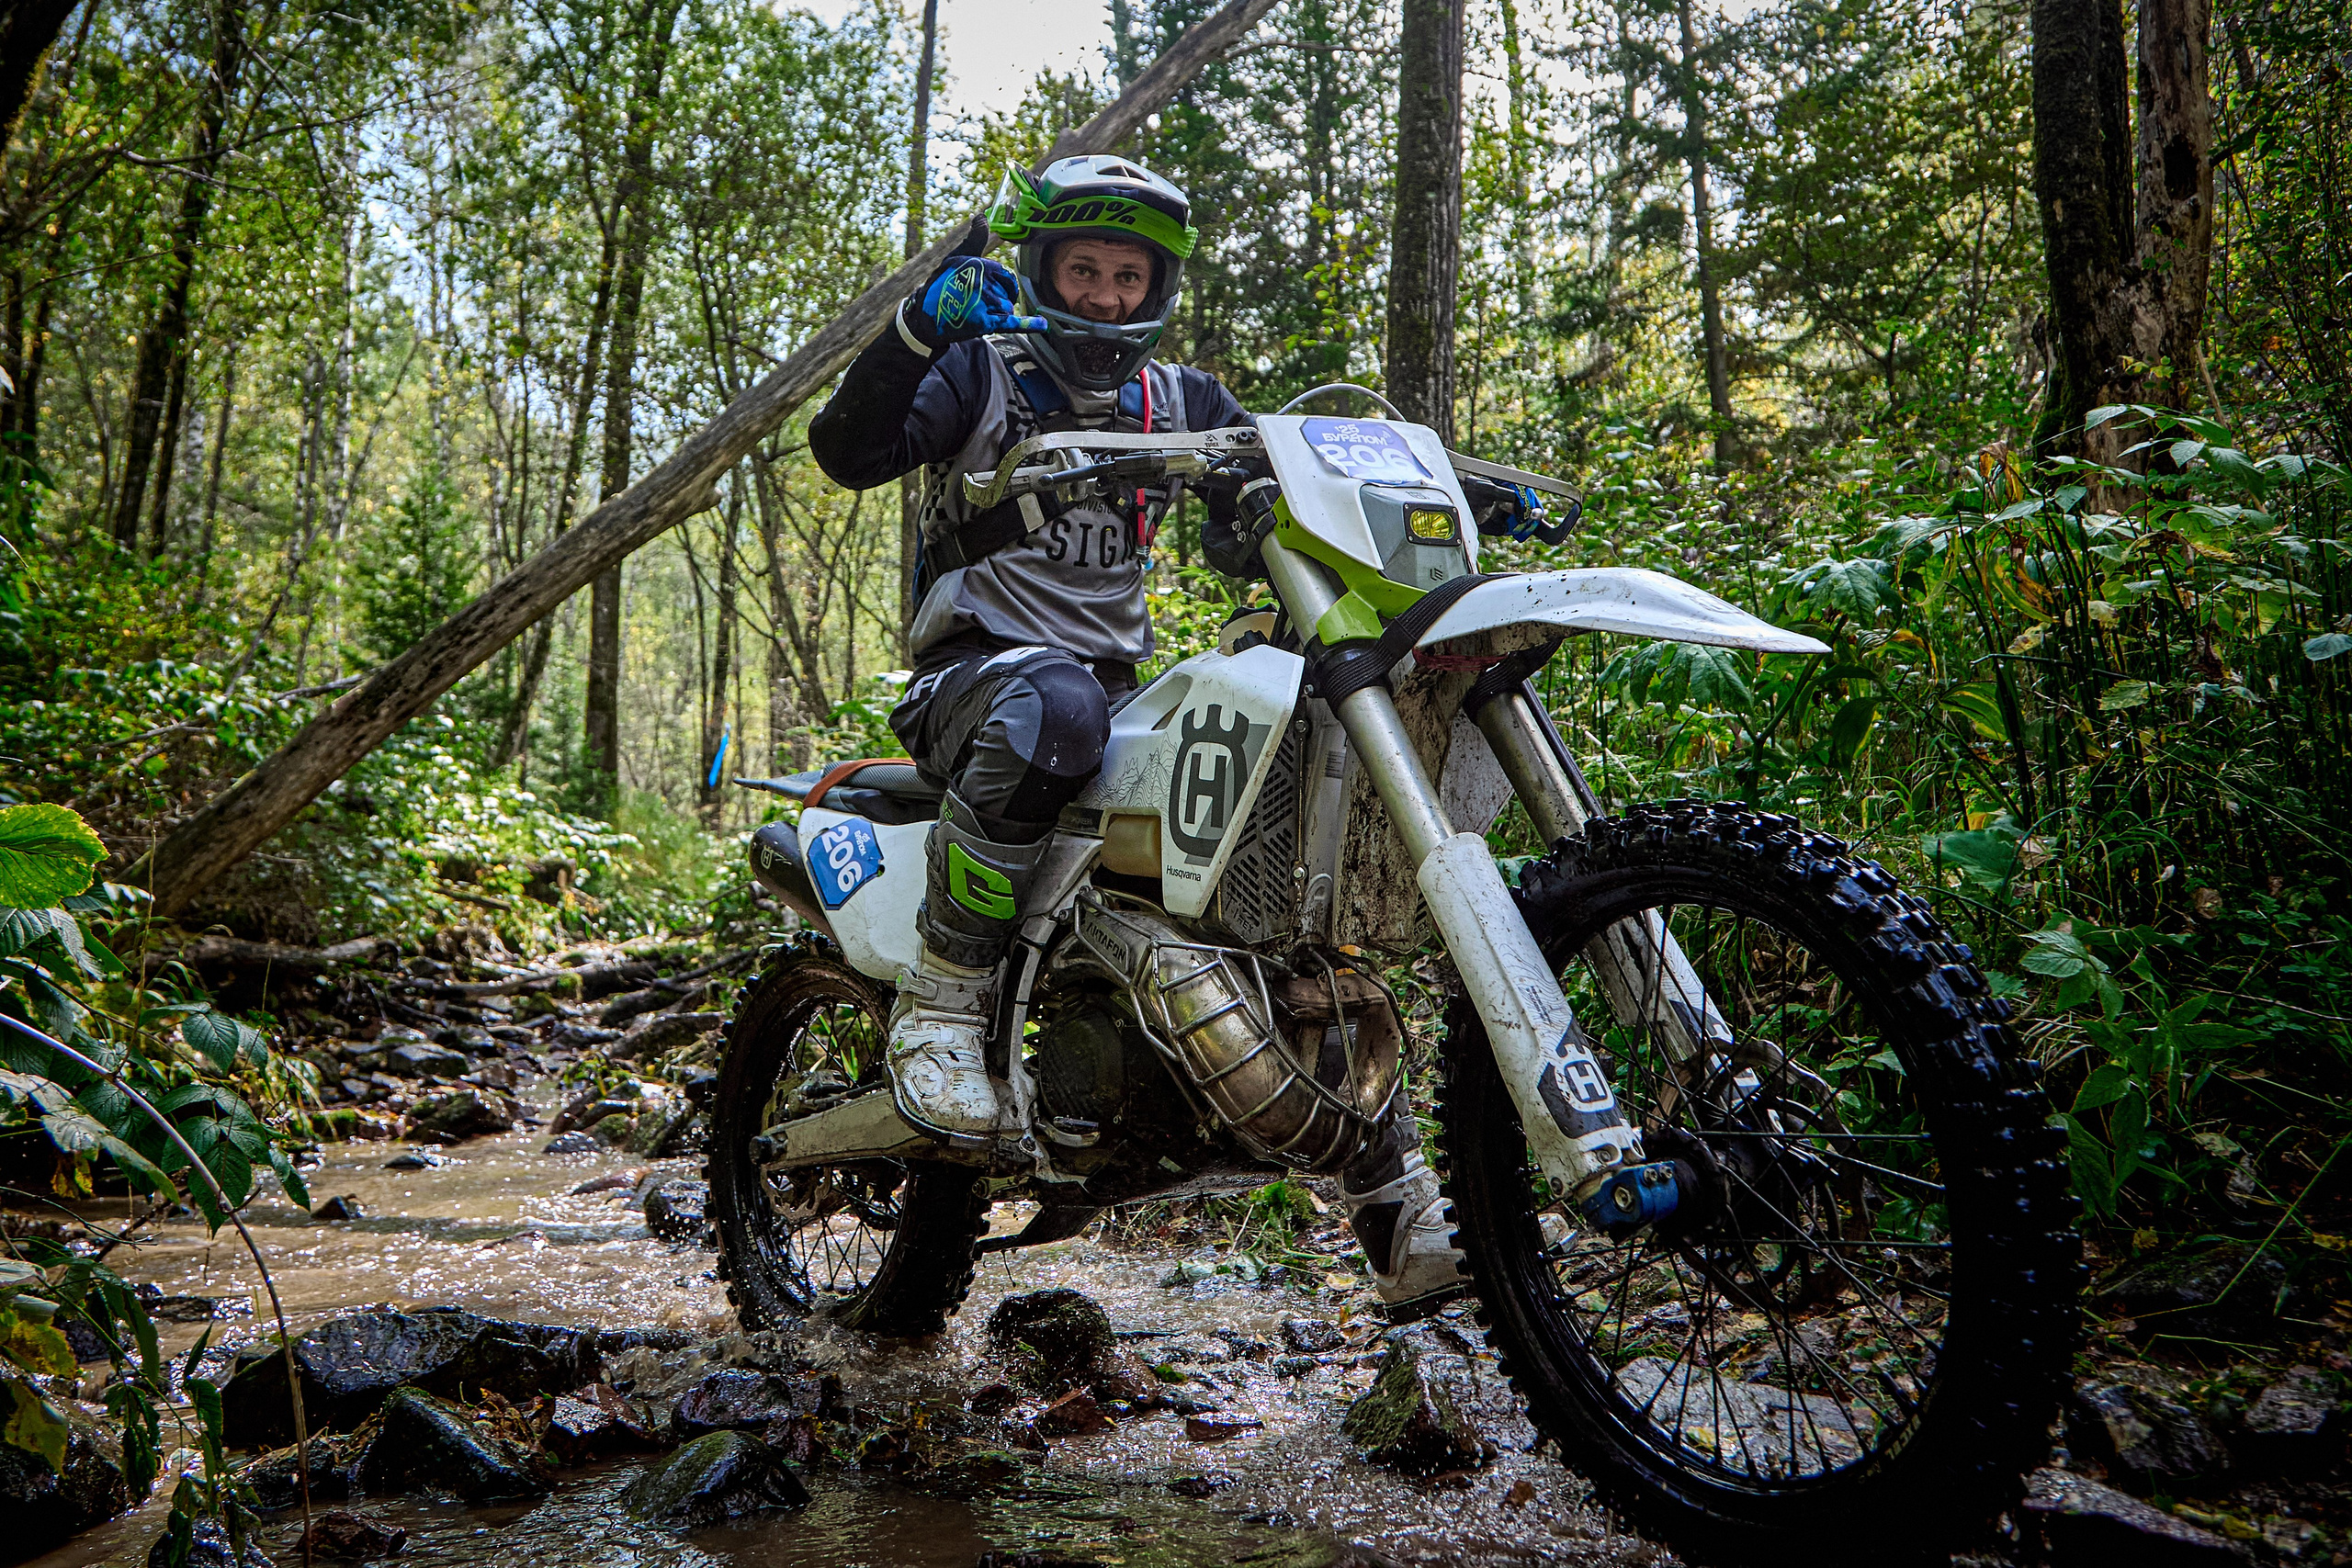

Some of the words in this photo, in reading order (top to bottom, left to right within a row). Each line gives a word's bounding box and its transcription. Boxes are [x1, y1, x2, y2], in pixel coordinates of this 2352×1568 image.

[1026, 200, 1139, 225] 100%
[1316, 444, 1417, 474] 206
[821, 825, 863, 893] 206
[1166, 865, 1202, 882] Husqvarna
